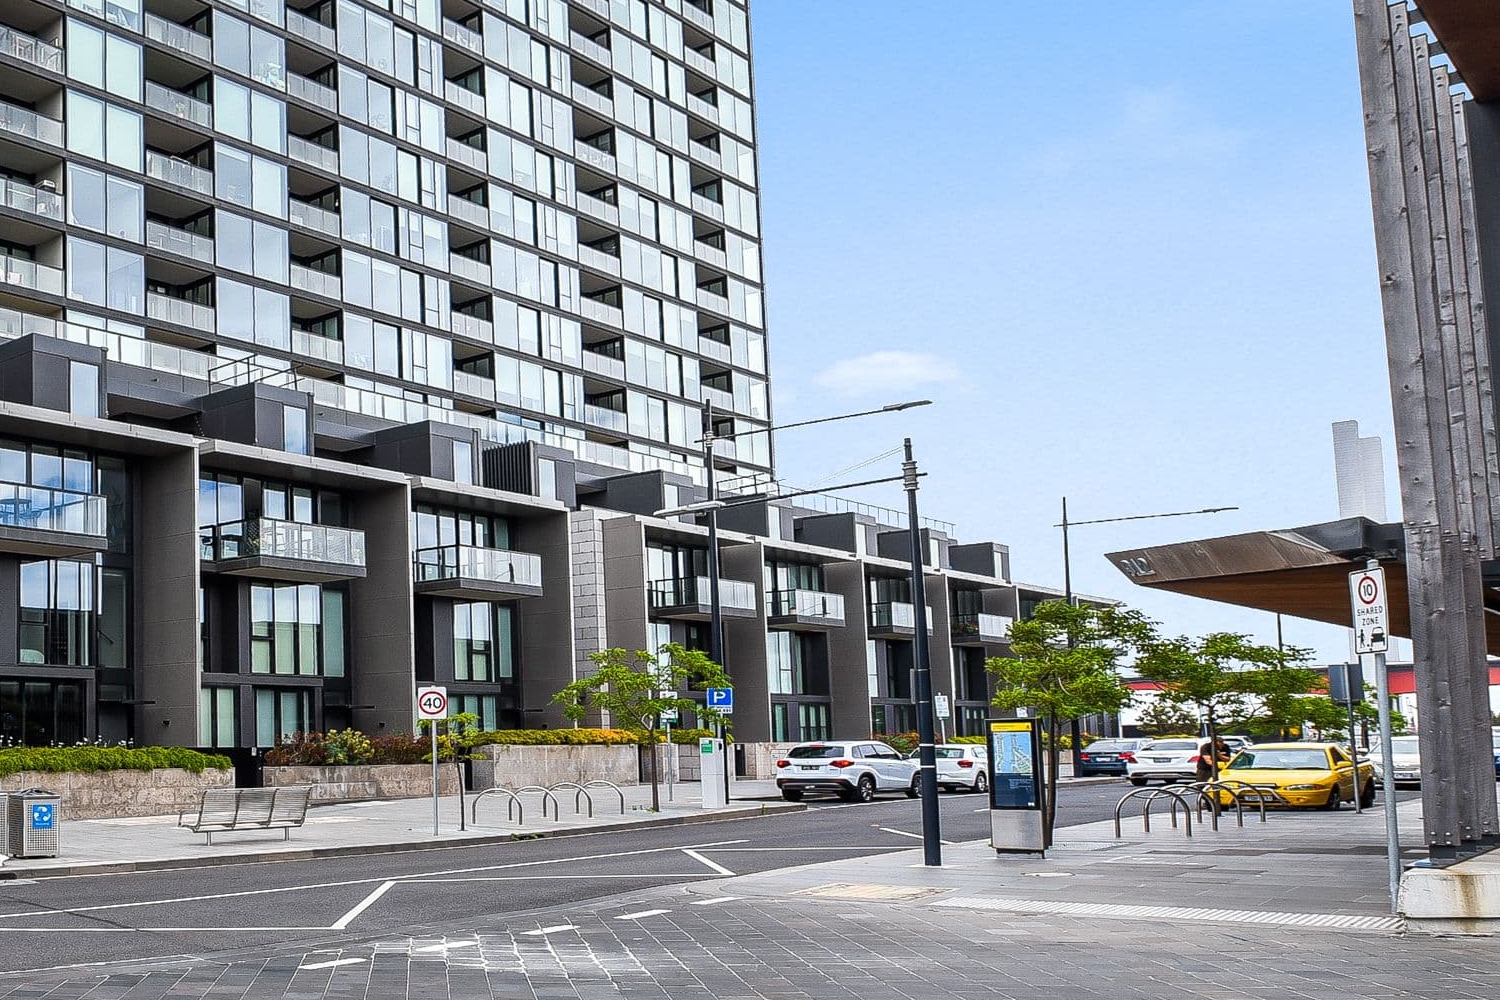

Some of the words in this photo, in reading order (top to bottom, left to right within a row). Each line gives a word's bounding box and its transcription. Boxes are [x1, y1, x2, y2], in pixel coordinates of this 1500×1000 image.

[1363, 584, 1373, 597] 10
[1357, 606, 1383, 616] SHARED
[1362, 617, 1379, 625] ZONE
[423, 697, 442, 709] 40
[713, 691, 726, 704] P
